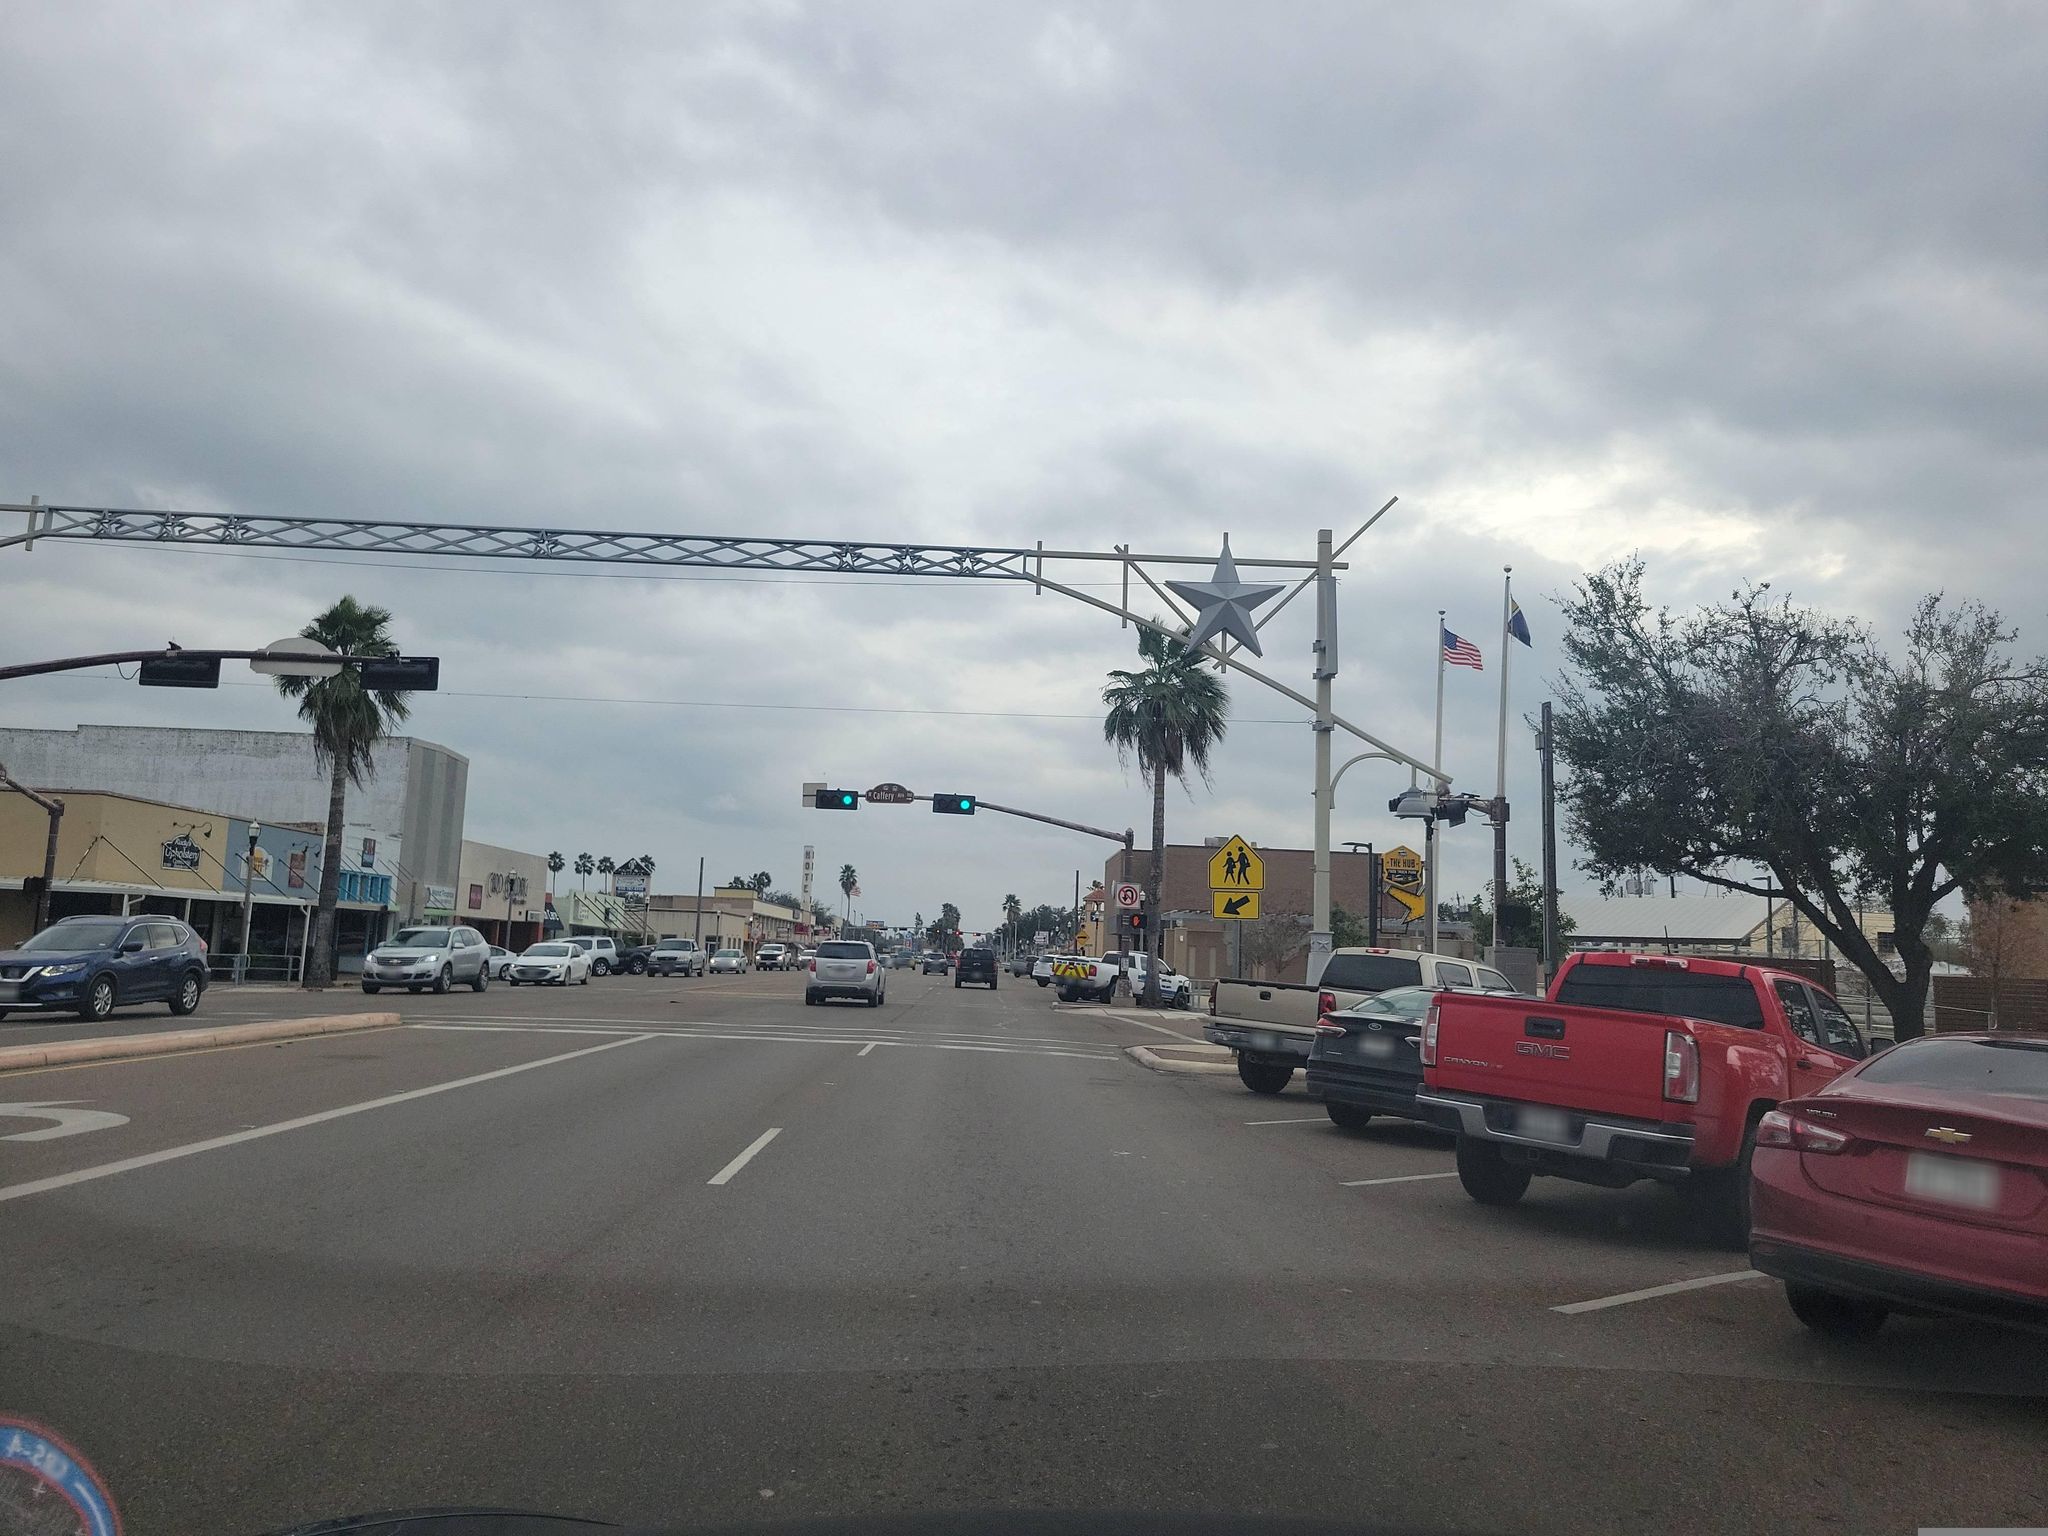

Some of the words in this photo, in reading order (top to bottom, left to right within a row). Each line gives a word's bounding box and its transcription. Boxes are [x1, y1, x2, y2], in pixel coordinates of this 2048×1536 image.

[873, 791, 895, 802] Caffery
[165, 847, 199, 862] Upholstery
[1390, 858, 1401, 868] THE
[1402, 858, 1415, 868] HUB
[1515, 1041, 1571, 1060] GMC
[1443, 1056, 1489, 1068] CANYON
